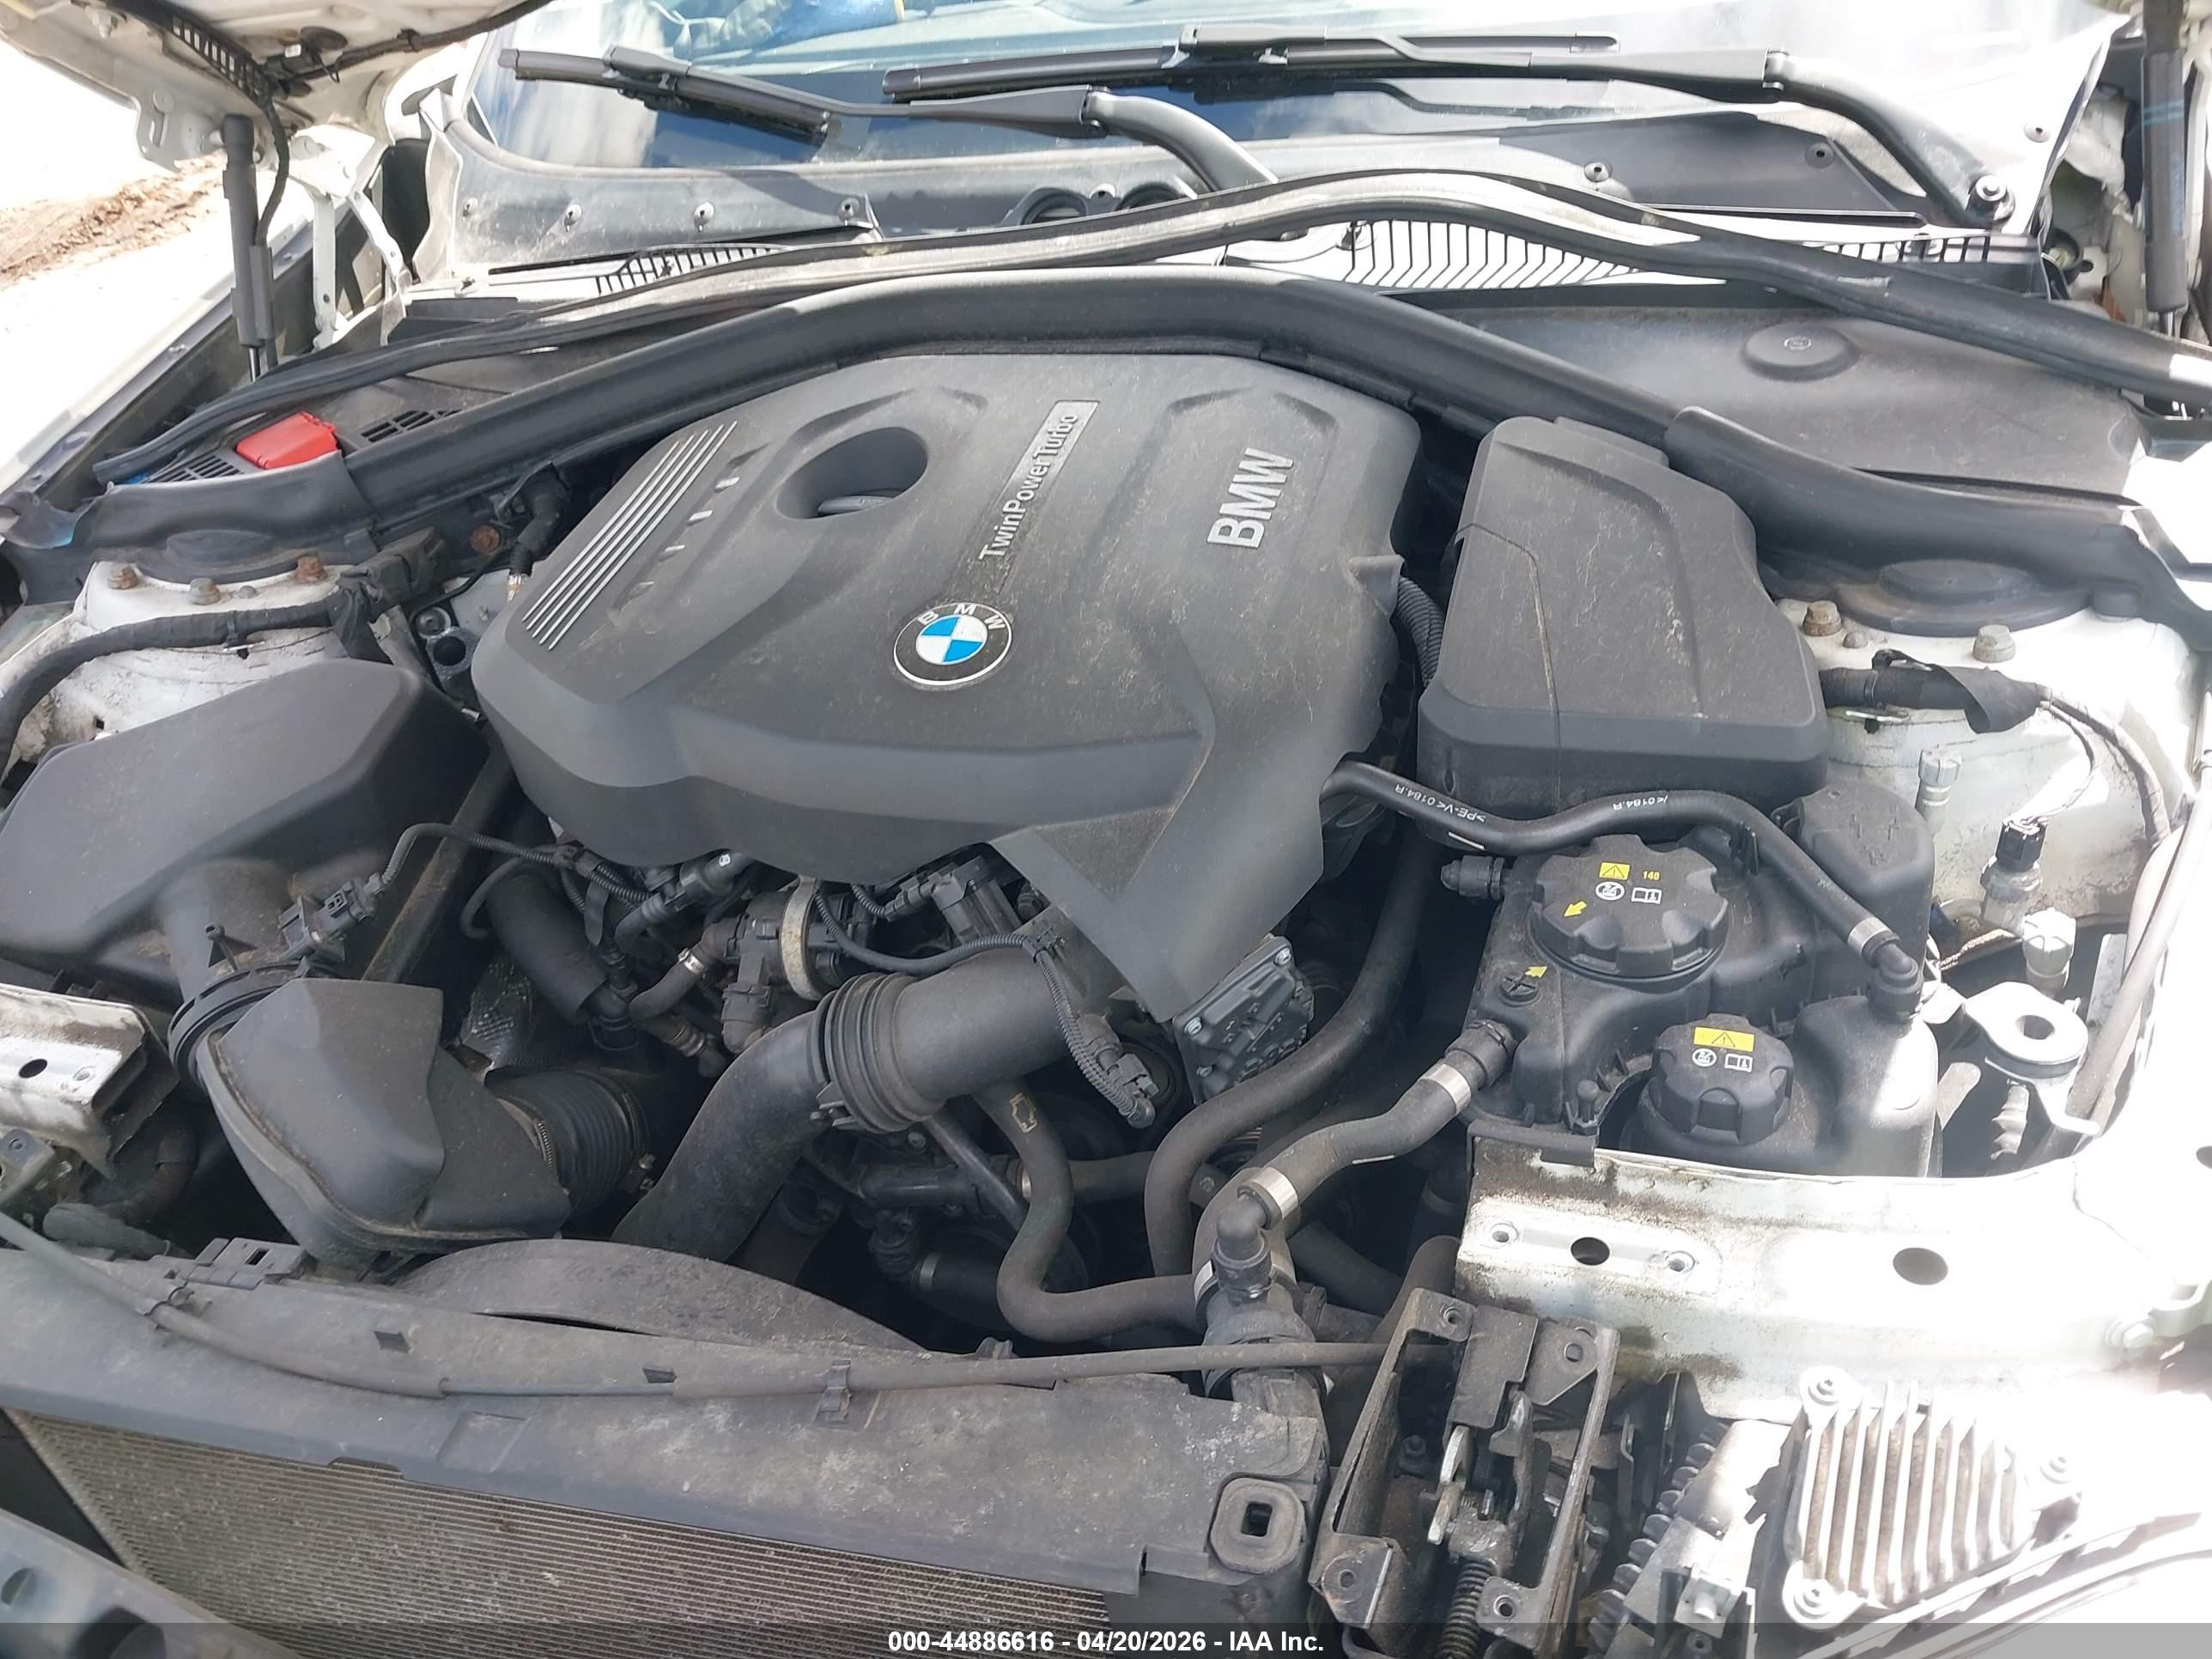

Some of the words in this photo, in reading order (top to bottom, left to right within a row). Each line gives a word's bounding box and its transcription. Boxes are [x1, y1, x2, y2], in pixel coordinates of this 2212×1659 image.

[1206, 447, 1293, 550] BMW
[917, 603, 1006, 630] BMW
[1643, 870, 1661, 881] 140
